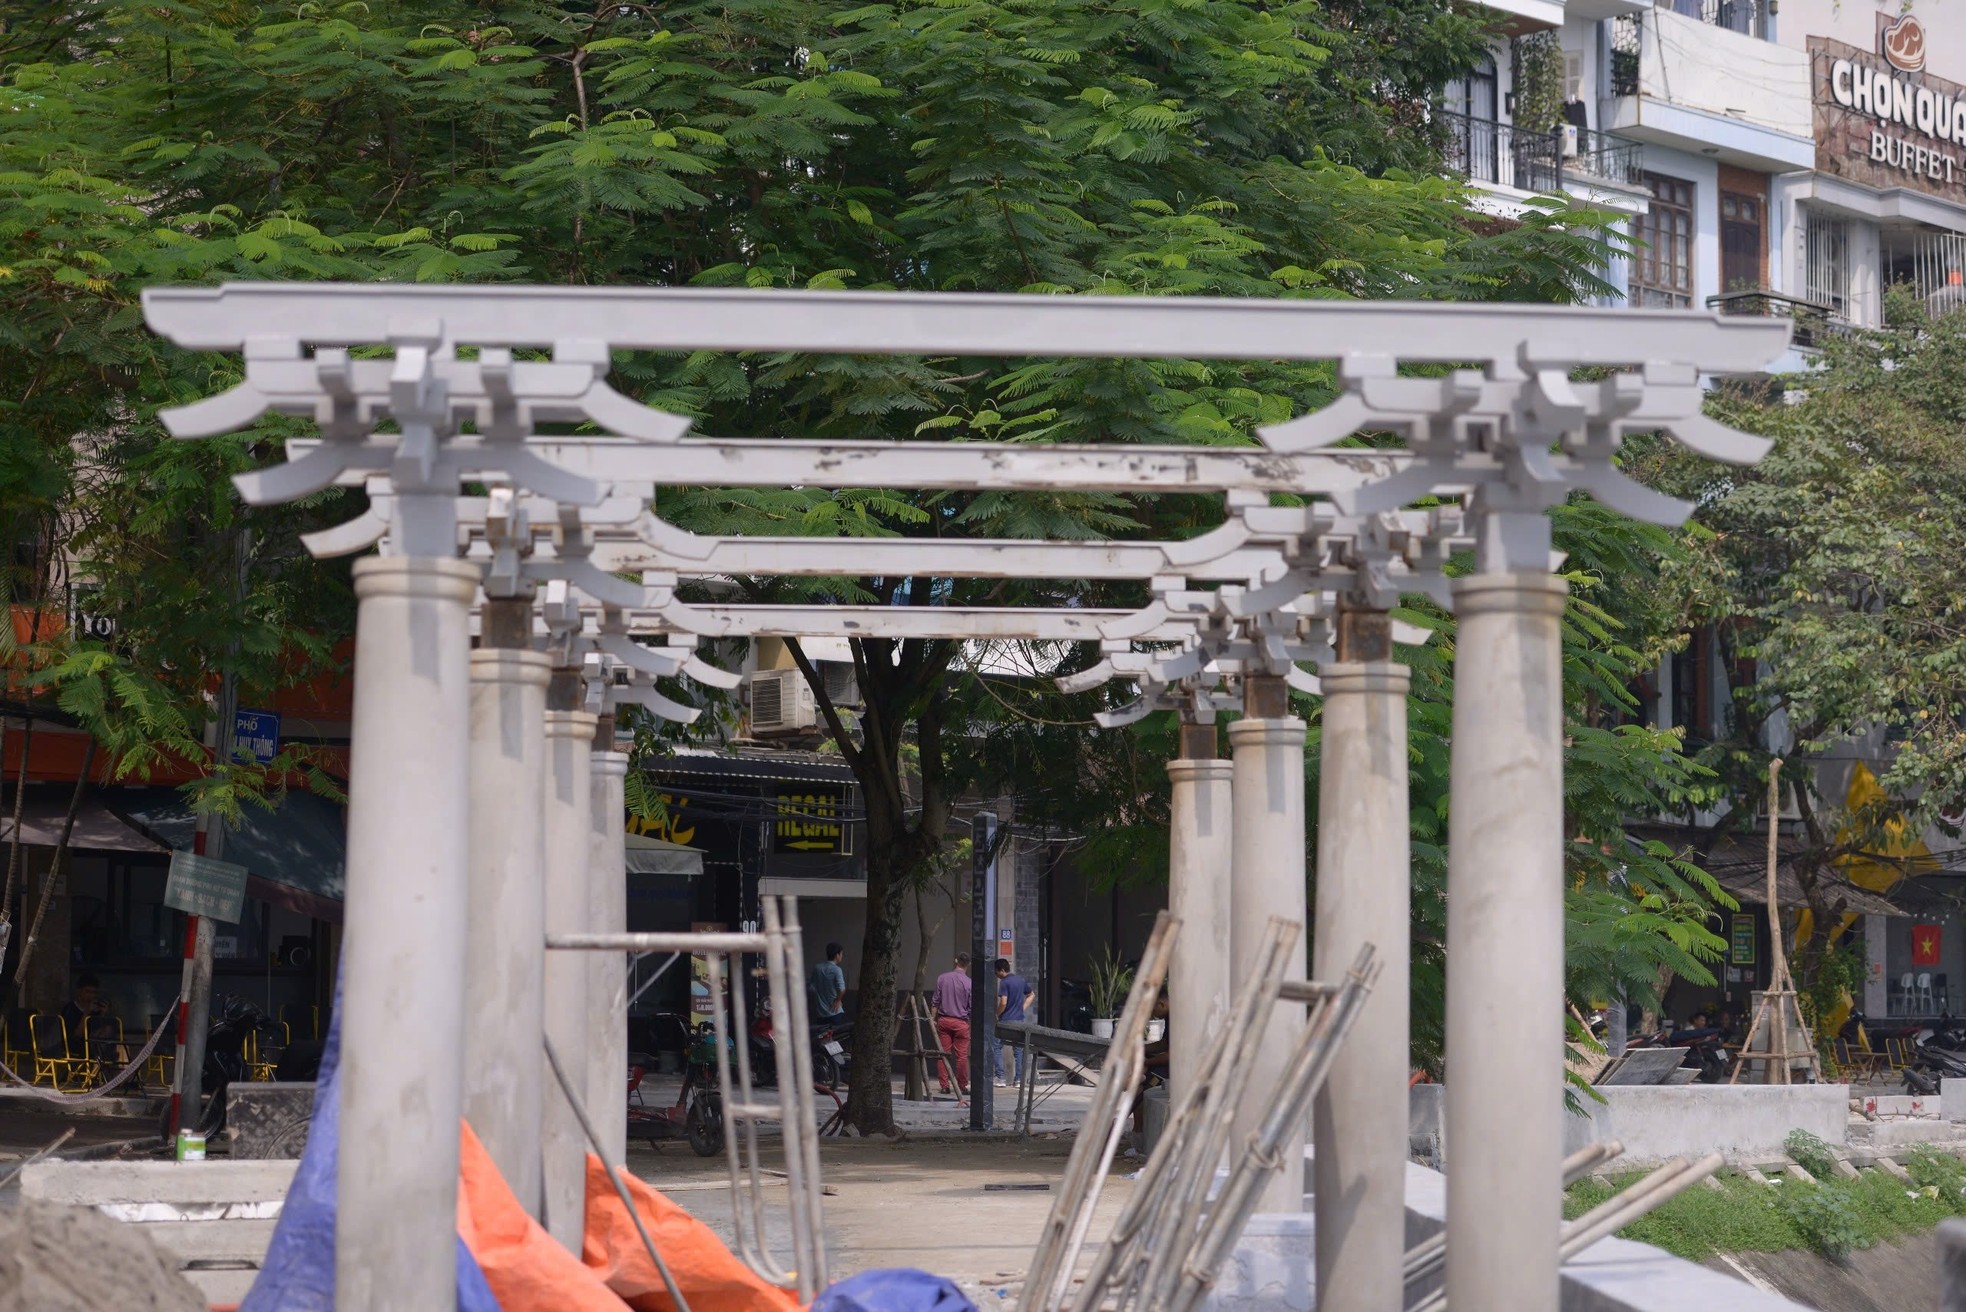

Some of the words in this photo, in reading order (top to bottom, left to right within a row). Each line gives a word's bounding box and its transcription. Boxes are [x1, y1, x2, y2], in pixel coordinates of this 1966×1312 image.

[1832, 59, 1912, 128] CHỌN
[1870, 131, 1956, 183] BUFFET
[777, 795, 840, 837] REGAL
[1002, 930, 1011, 939] 88
